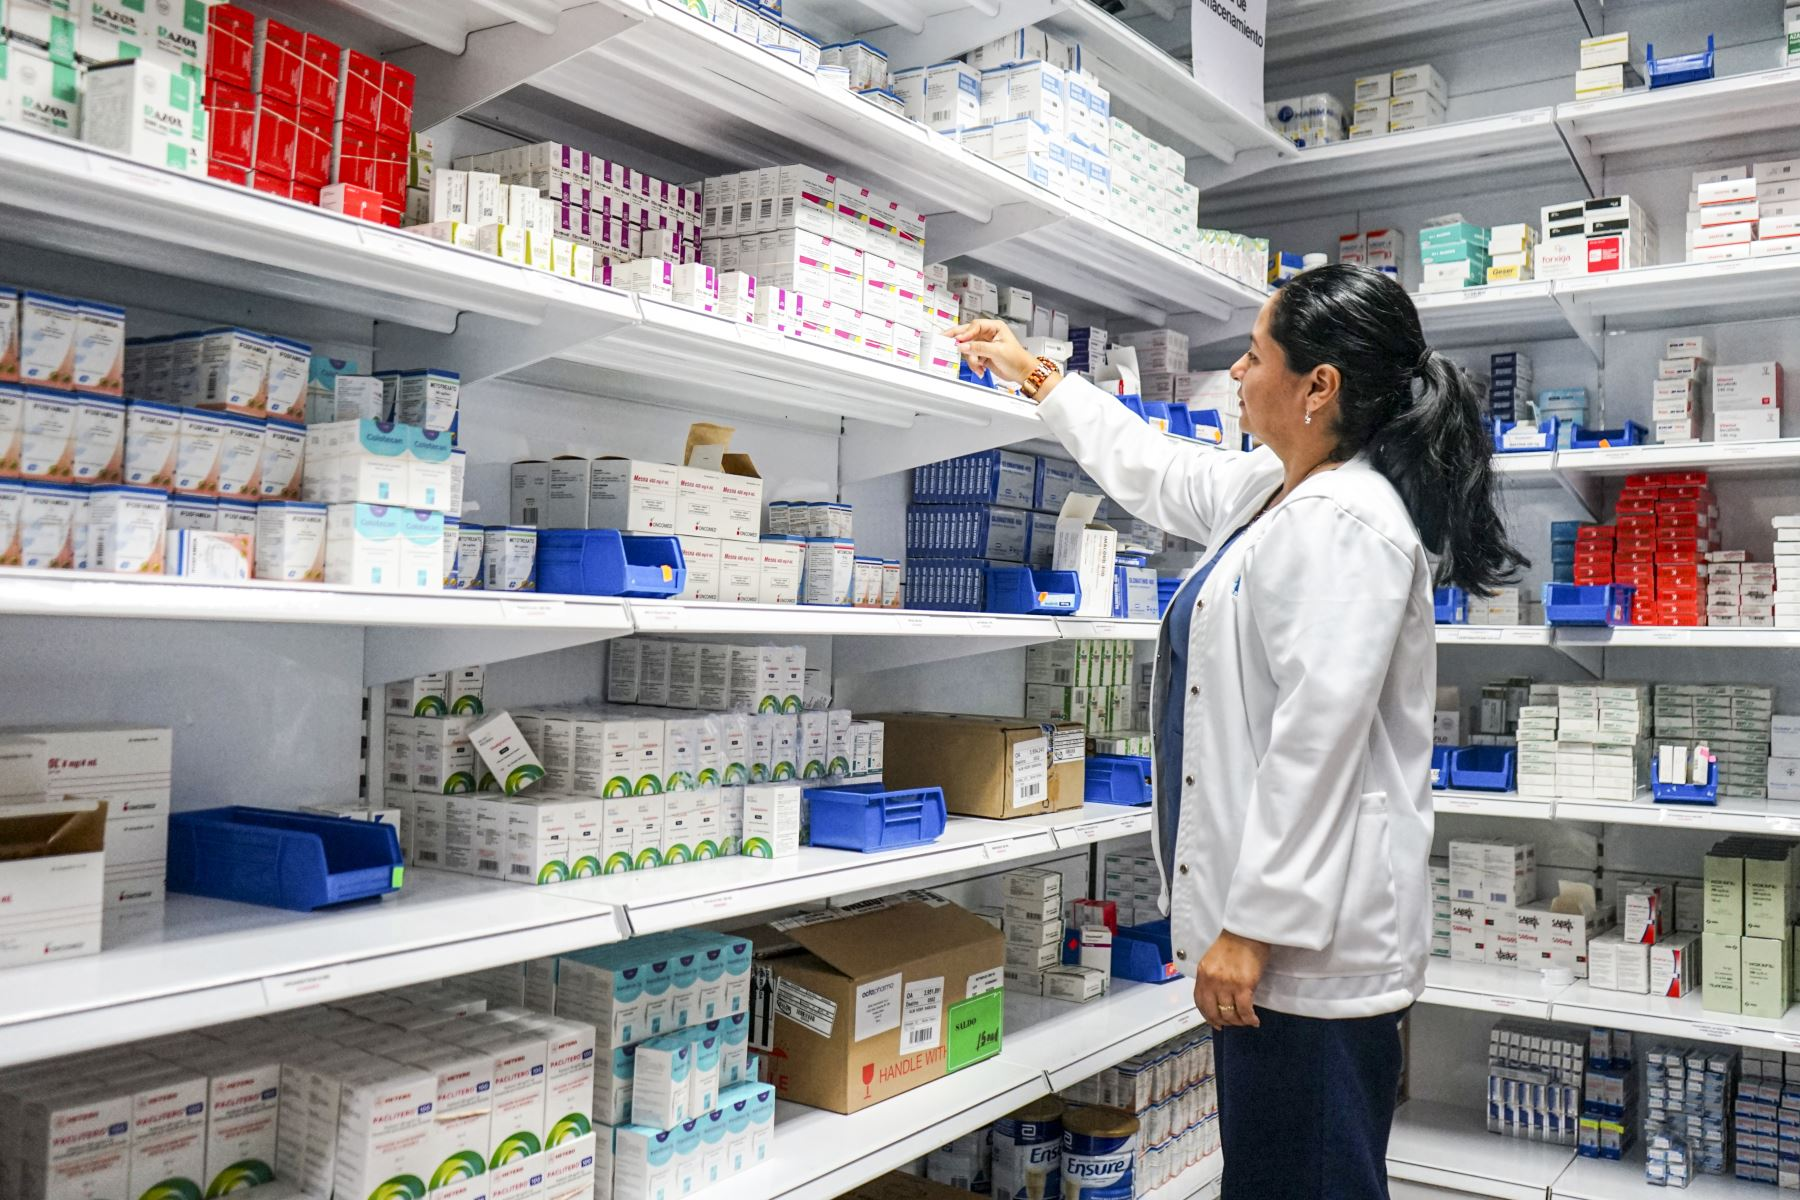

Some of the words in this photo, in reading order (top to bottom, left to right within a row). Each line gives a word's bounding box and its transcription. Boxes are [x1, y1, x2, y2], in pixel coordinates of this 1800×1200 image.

[634, 474, 649, 483] Mesna
[955, 1017, 977, 1031] SALDO
[880, 1054, 922, 1083] HANDLE
[1067, 1158, 1125, 1176] Ensure
